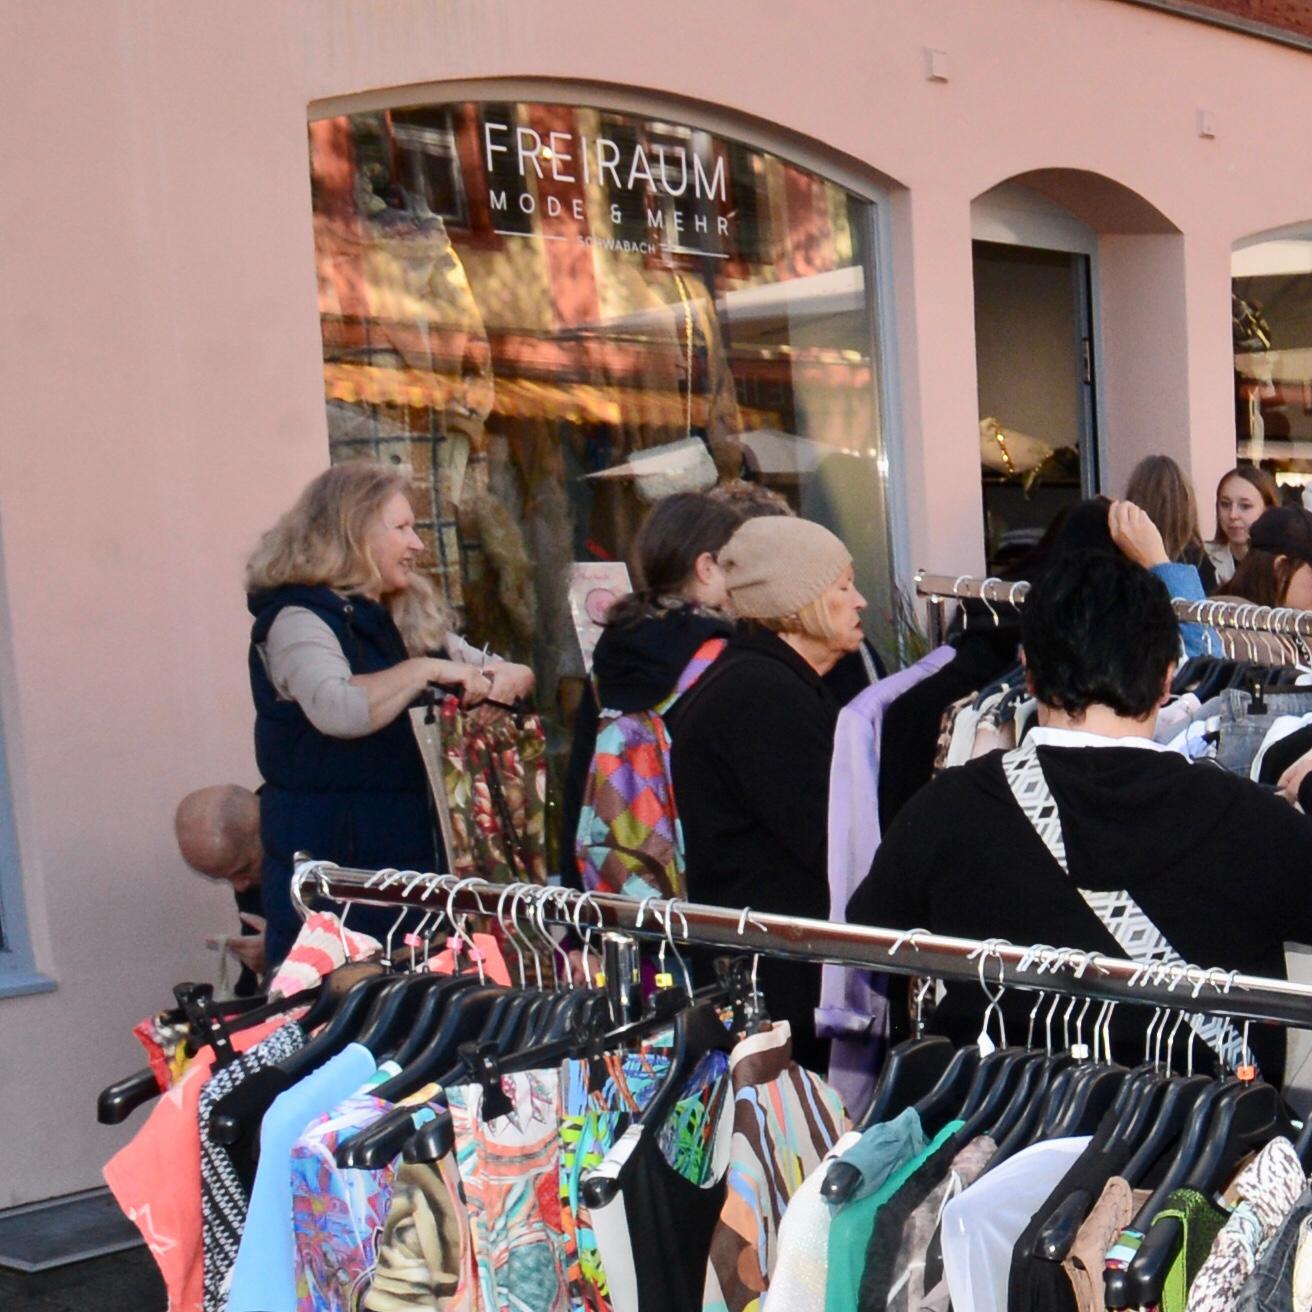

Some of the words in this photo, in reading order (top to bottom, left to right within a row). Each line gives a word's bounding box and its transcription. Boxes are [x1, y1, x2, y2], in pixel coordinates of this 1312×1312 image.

[485, 122, 726, 202] FREIRAUM
[489, 190, 584, 220] MODE
[610, 204, 622, 224] &
[647, 208, 729, 236] MEHR
[577, 235, 656, 255] SCHWABACH
